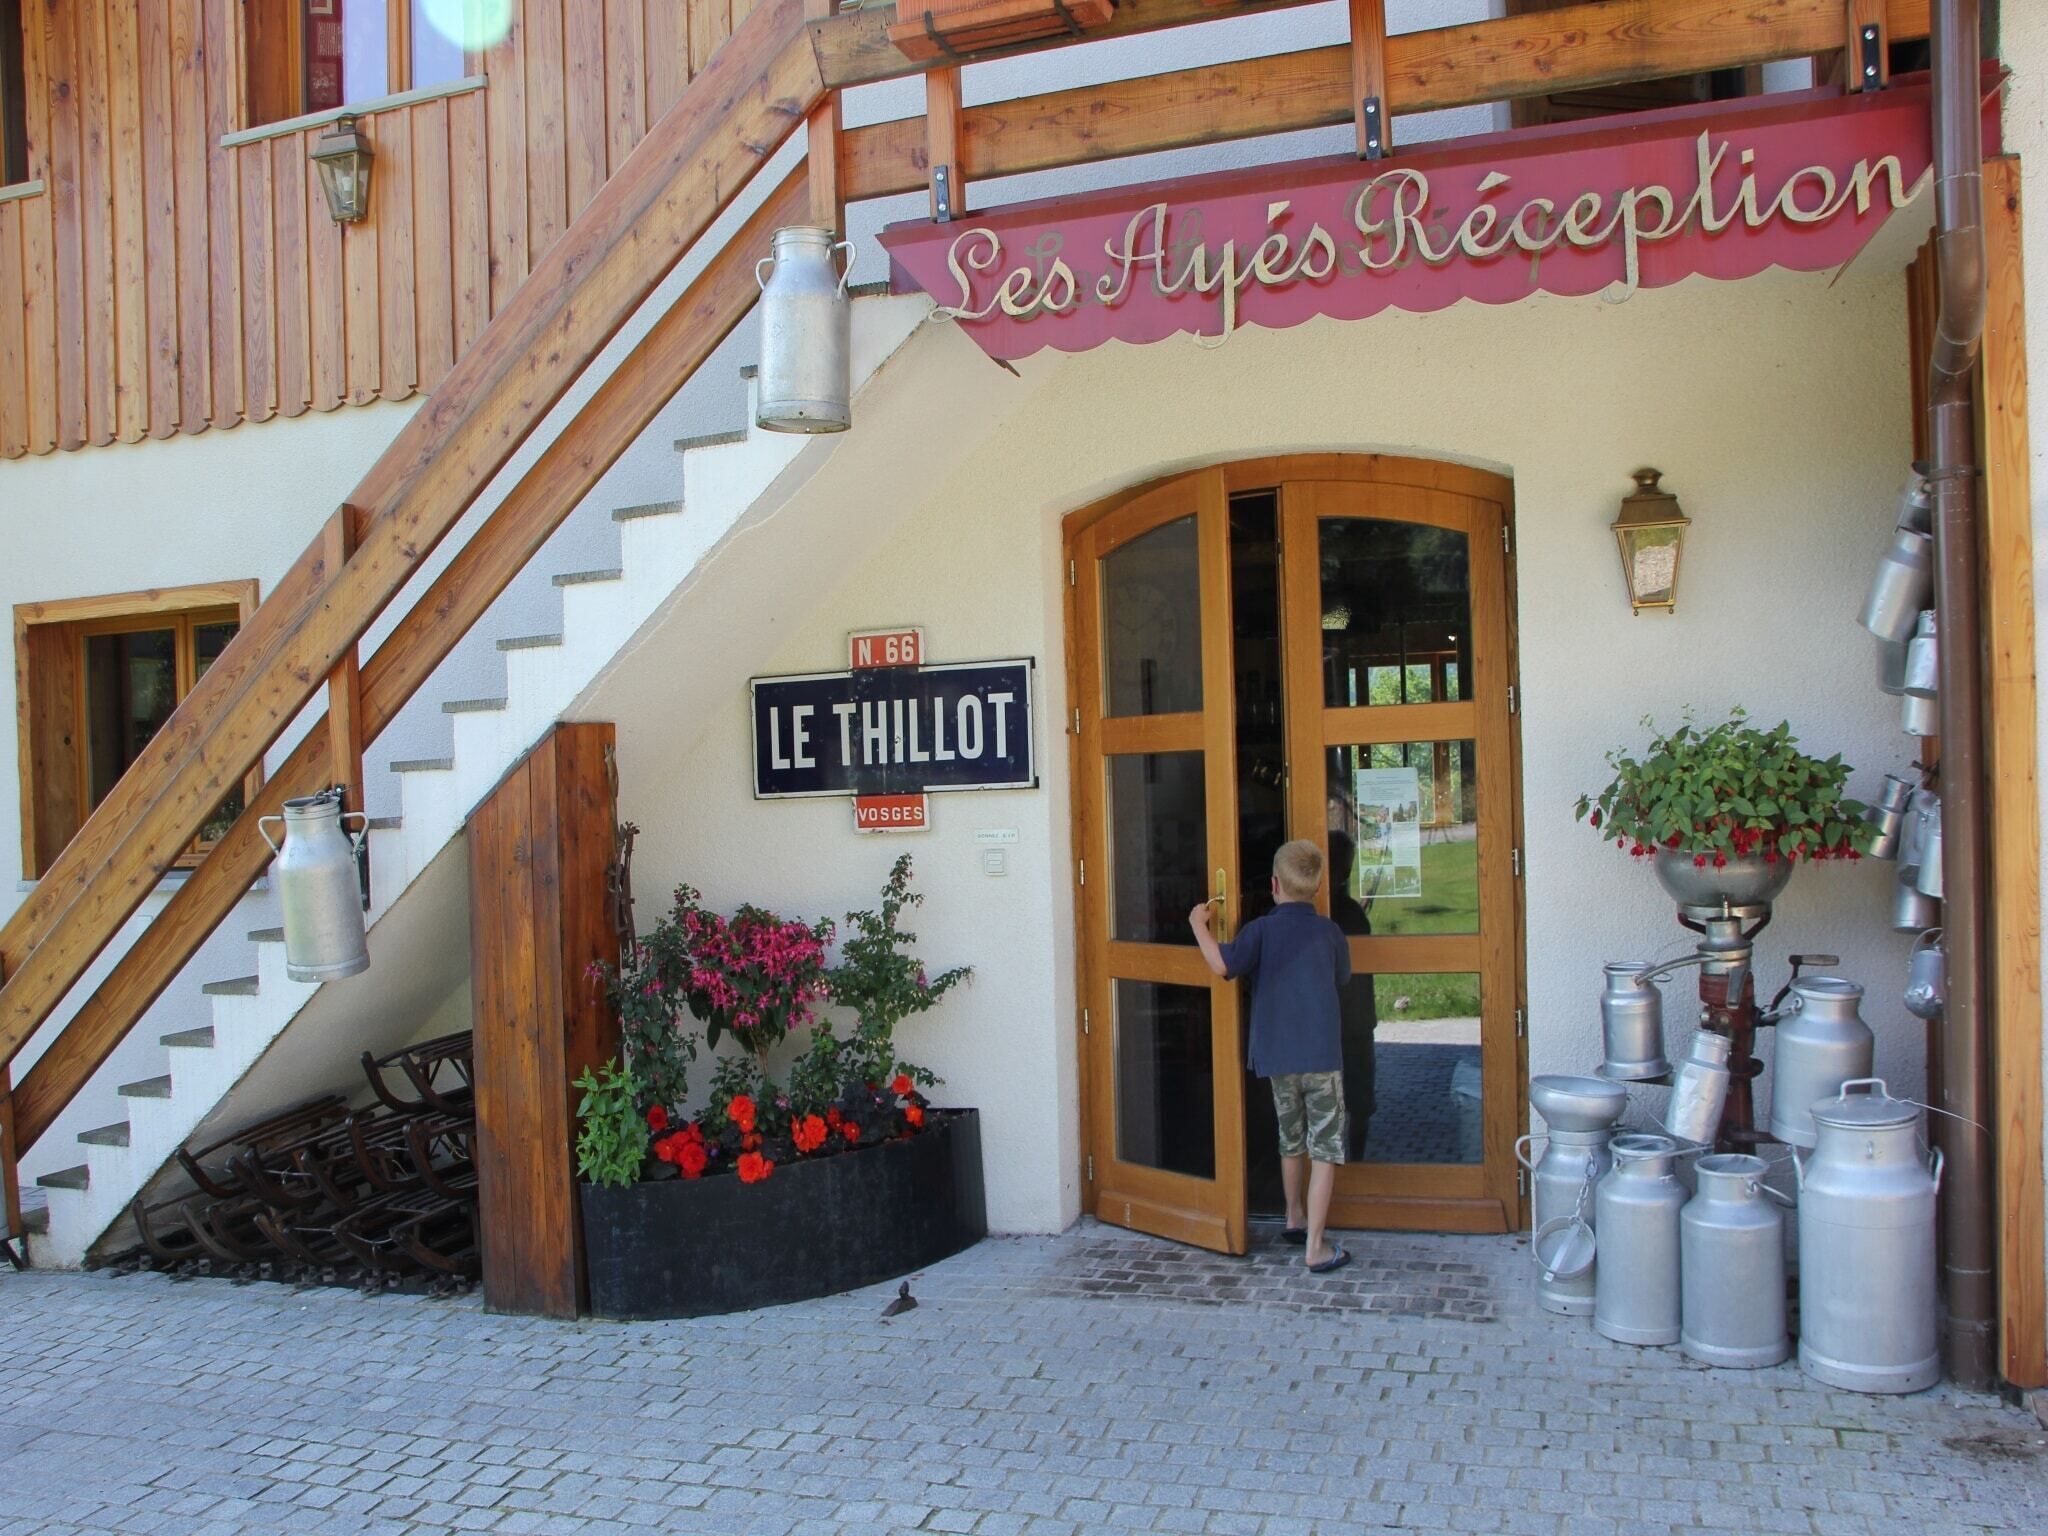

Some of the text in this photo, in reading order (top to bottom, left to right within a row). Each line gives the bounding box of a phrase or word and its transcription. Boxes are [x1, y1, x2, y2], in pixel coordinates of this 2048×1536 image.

[928, 128, 1934, 350] Les Ayés Réception
[885, 635, 915, 664] 66
[769, 691, 1014, 770] LE THILLOT
[857, 806, 923, 822] VOSGES
